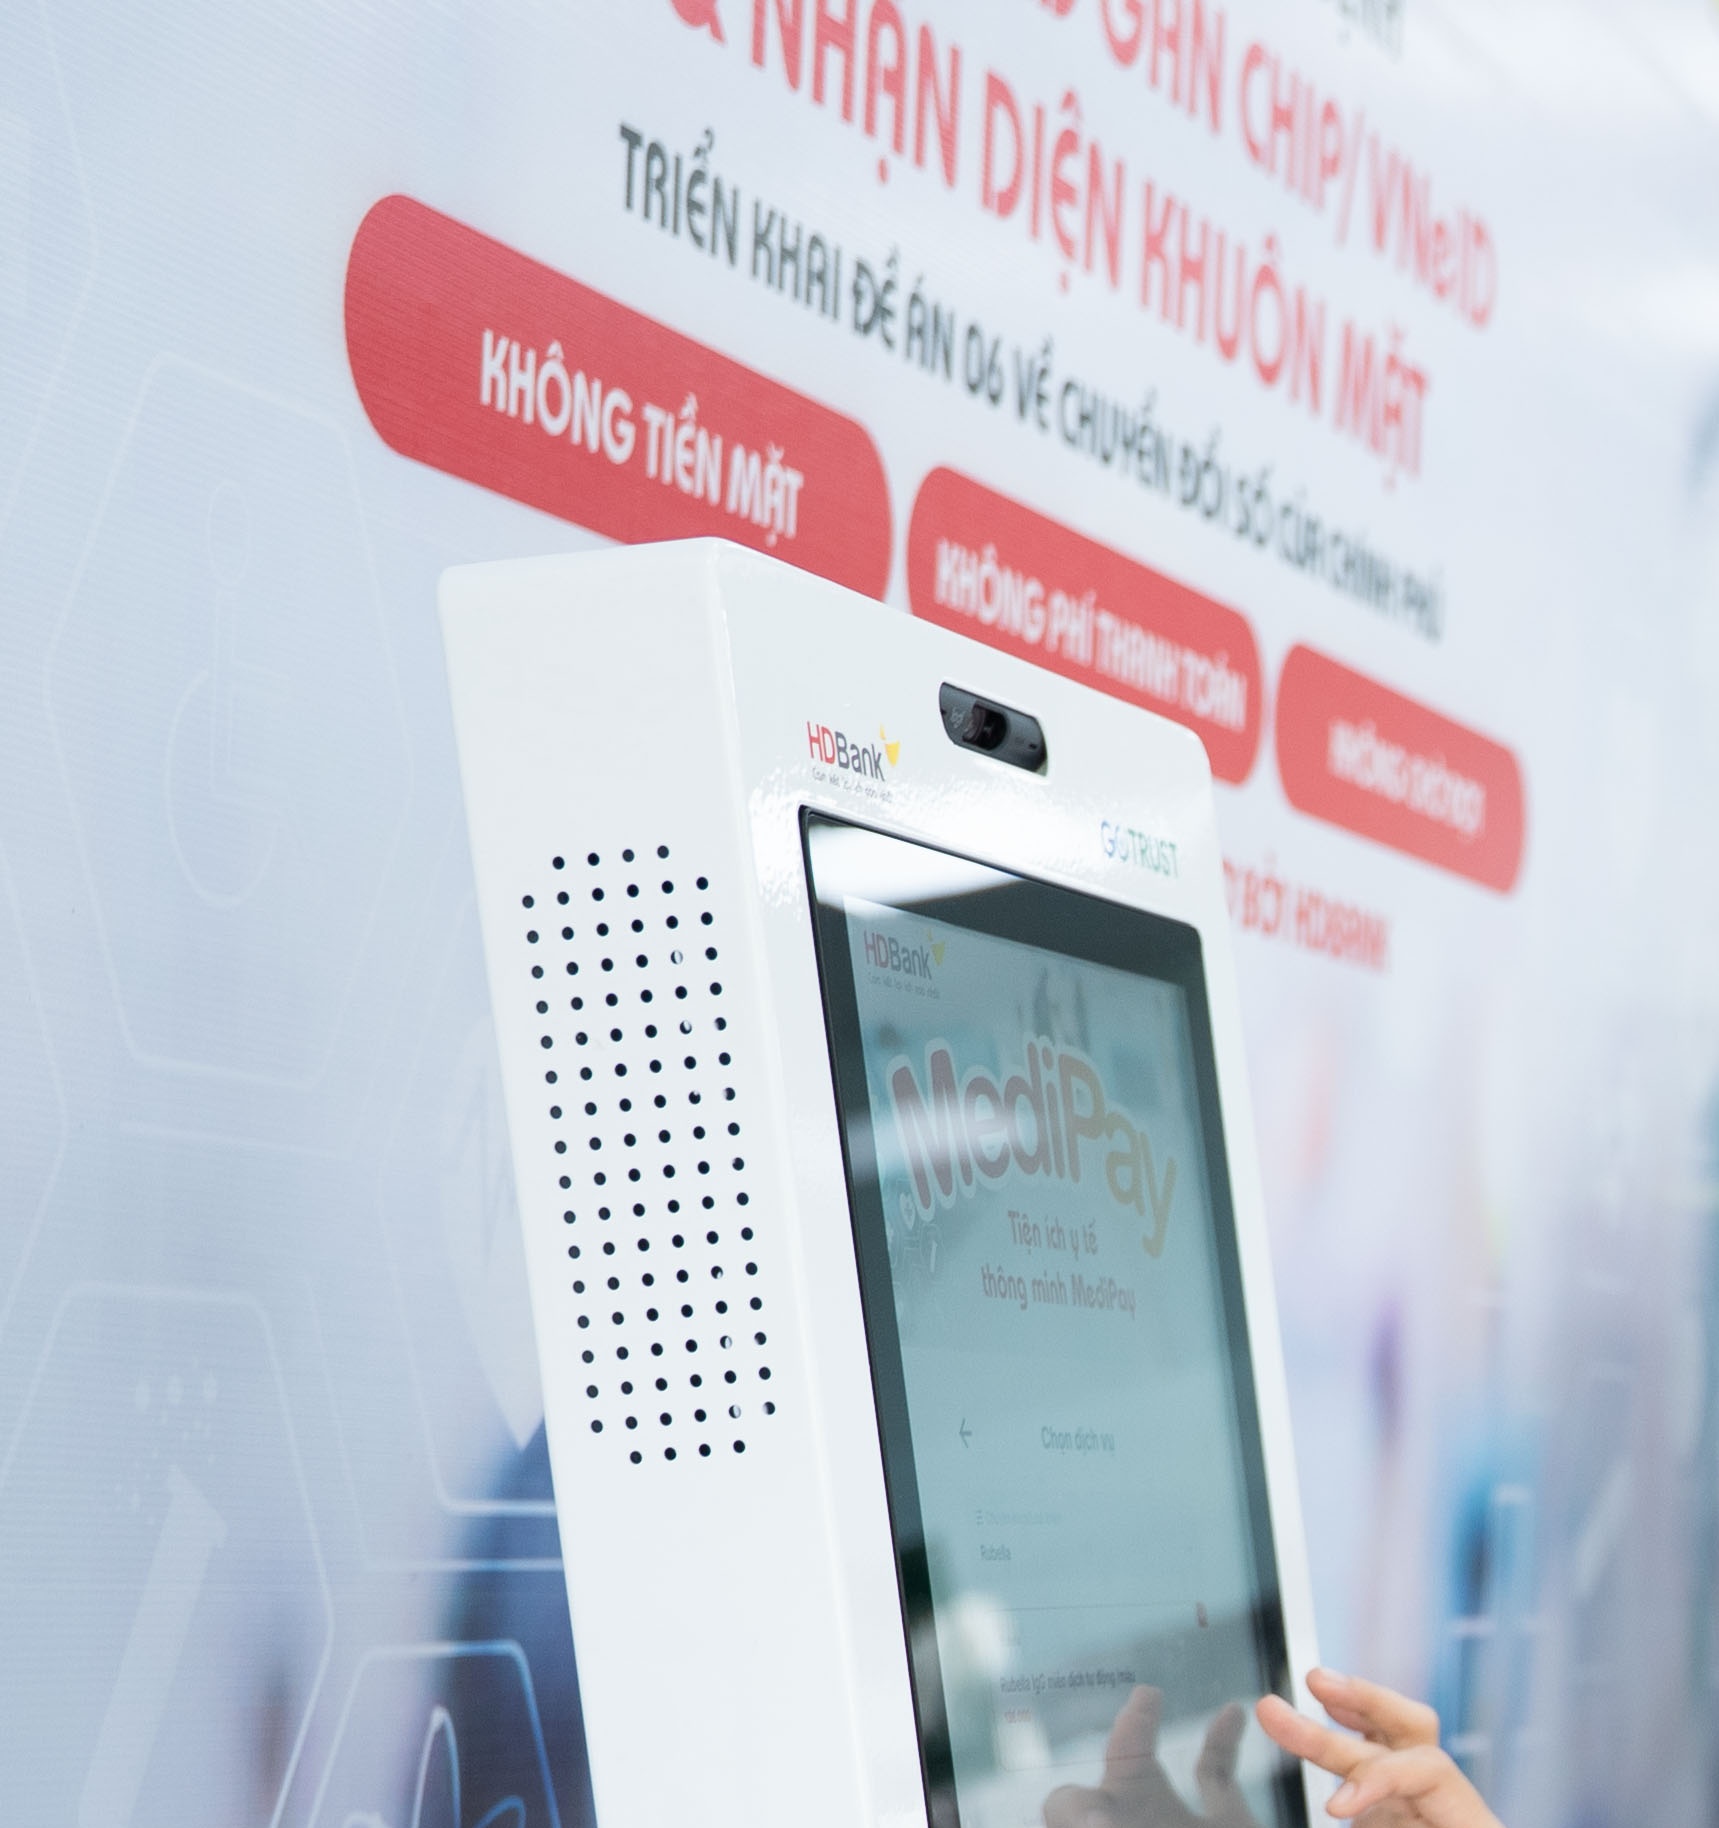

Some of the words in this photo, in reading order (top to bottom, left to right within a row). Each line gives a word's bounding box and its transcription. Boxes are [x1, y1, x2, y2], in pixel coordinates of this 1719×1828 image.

[619, 123, 740, 268] TRIỂN
[751, 199, 842, 321] KHAI
[906, 276, 955, 382] ÁN
[963, 321, 1005, 410] 06
[981, 70, 1126, 294] DIỆN
[1140, 177, 1325, 418] KHUÔN
[480, 327, 636, 465] KHÔNG
[643, 391, 723, 506] TIỀN
[727, 441, 803, 548] MẶT
[933, 537, 1046, 643] KHÔNG
[1046, 592, 1097, 667] PHÍ
[1096, 610, 1181, 696] THANH
[1181, 637, 1247, 732] TOÁN
[806, 720, 885, 782] HDBank
[1100, 820, 1180, 878] GOTRUST
[864, 929, 932, 980] HDBank
[891, 1041, 1177, 1258] MediPay
[981, 1263, 1028, 1311] thông
[1032, 1270, 1068, 1306] minh
[1071, 1273, 1136, 1320] MediPay
[1008, 1210, 1041, 1254] Tiện
[1045, 1215, 1066, 1250] ích
[1070, 1229, 1079, 1261] y
[1083, 1217, 1098, 1254] tế
